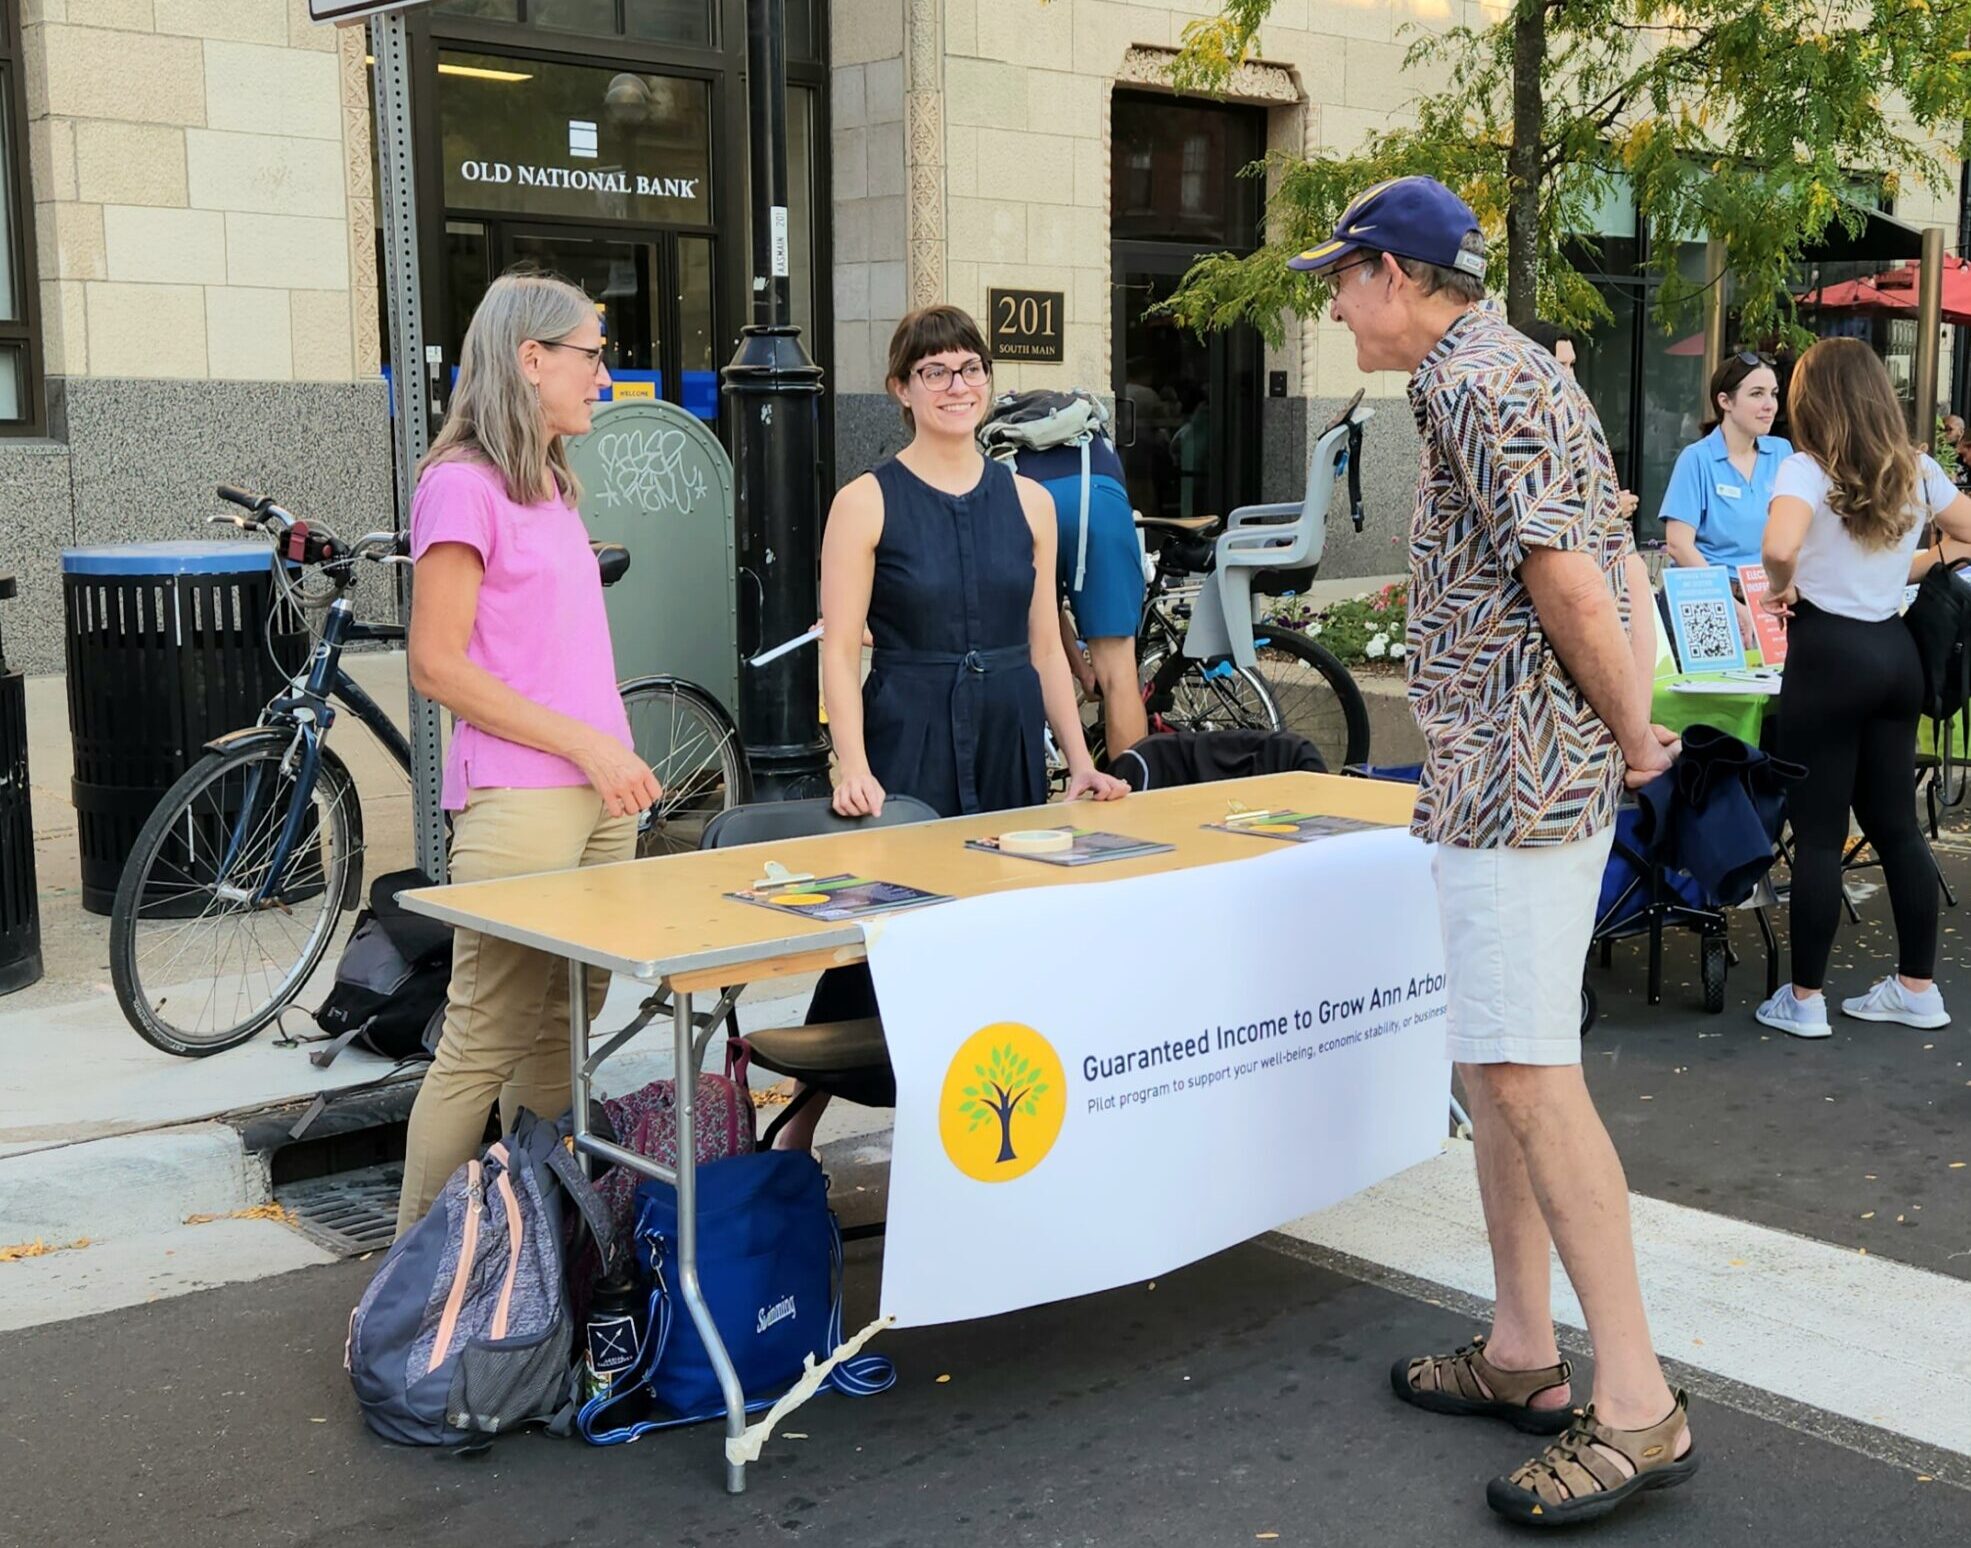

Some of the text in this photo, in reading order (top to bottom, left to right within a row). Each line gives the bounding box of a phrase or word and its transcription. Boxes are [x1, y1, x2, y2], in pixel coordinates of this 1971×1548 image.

[461, 161, 699, 198] OLD NATIONAL BANK
[998, 296, 1056, 335] 201
[999, 343, 1056, 355] SOUTH MAIN
[1083, 1028, 1210, 1082] Guaranteed
[1217, 1014, 1288, 1050] Income
[1294, 1008, 1313, 1031] to
[1319, 996, 1365, 1025] Grow
[1369, 986, 1401, 1012] Ann
[1087, 1004, 1448, 1114] Pilot program to support your well-being, economic stability, or business
